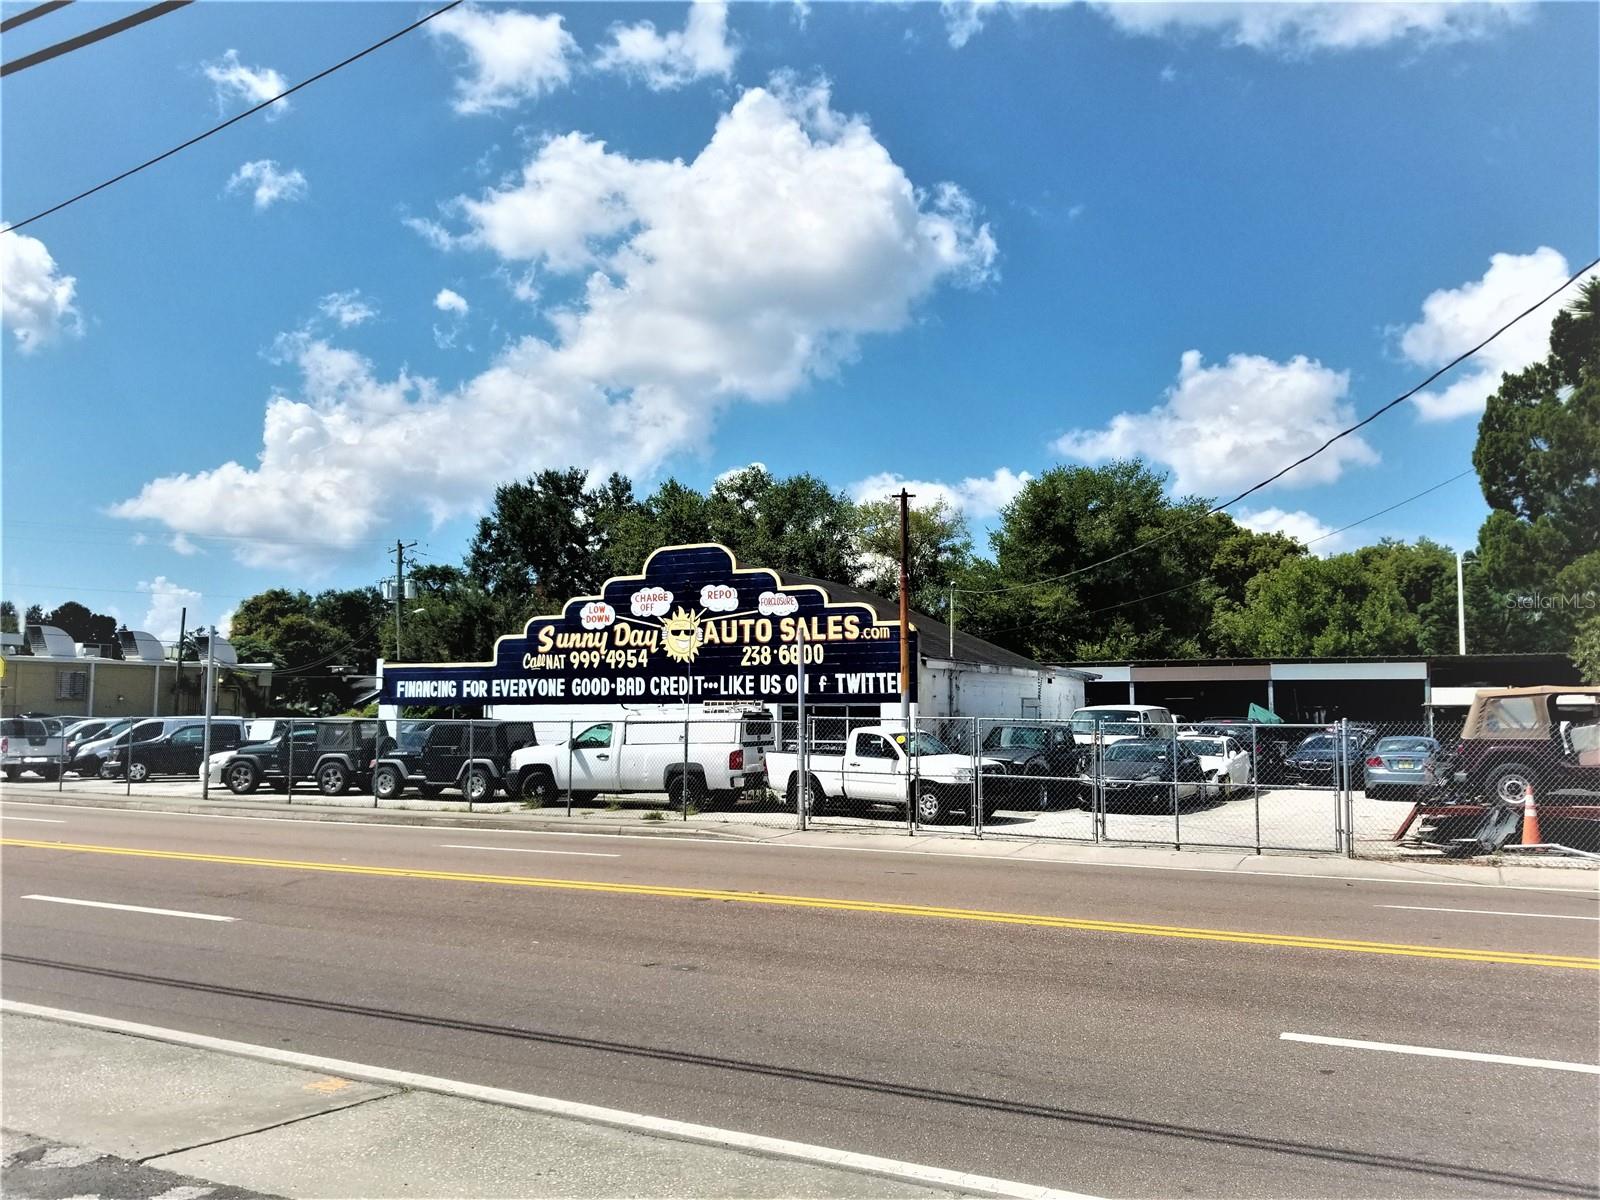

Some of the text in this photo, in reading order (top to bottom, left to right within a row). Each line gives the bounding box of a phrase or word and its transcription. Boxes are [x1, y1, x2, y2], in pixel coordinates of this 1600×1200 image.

[635, 593, 668, 602] CHARGE
[588, 606, 605, 614] LOW
[640, 604, 654, 612] OFF
[586, 614, 610, 623] DOWN
[538, 625, 608, 656] Sunny
[613, 622, 659, 653] Day
[703, 618, 773, 645] AUTO
[397, 680, 457, 698] FINANCING
[463, 680, 488, 698] FOR
[492, 678, 565, 698] EVERYONE
[760, 674, 782, 694] US
[835, 672, 903, 694] TWITTE
